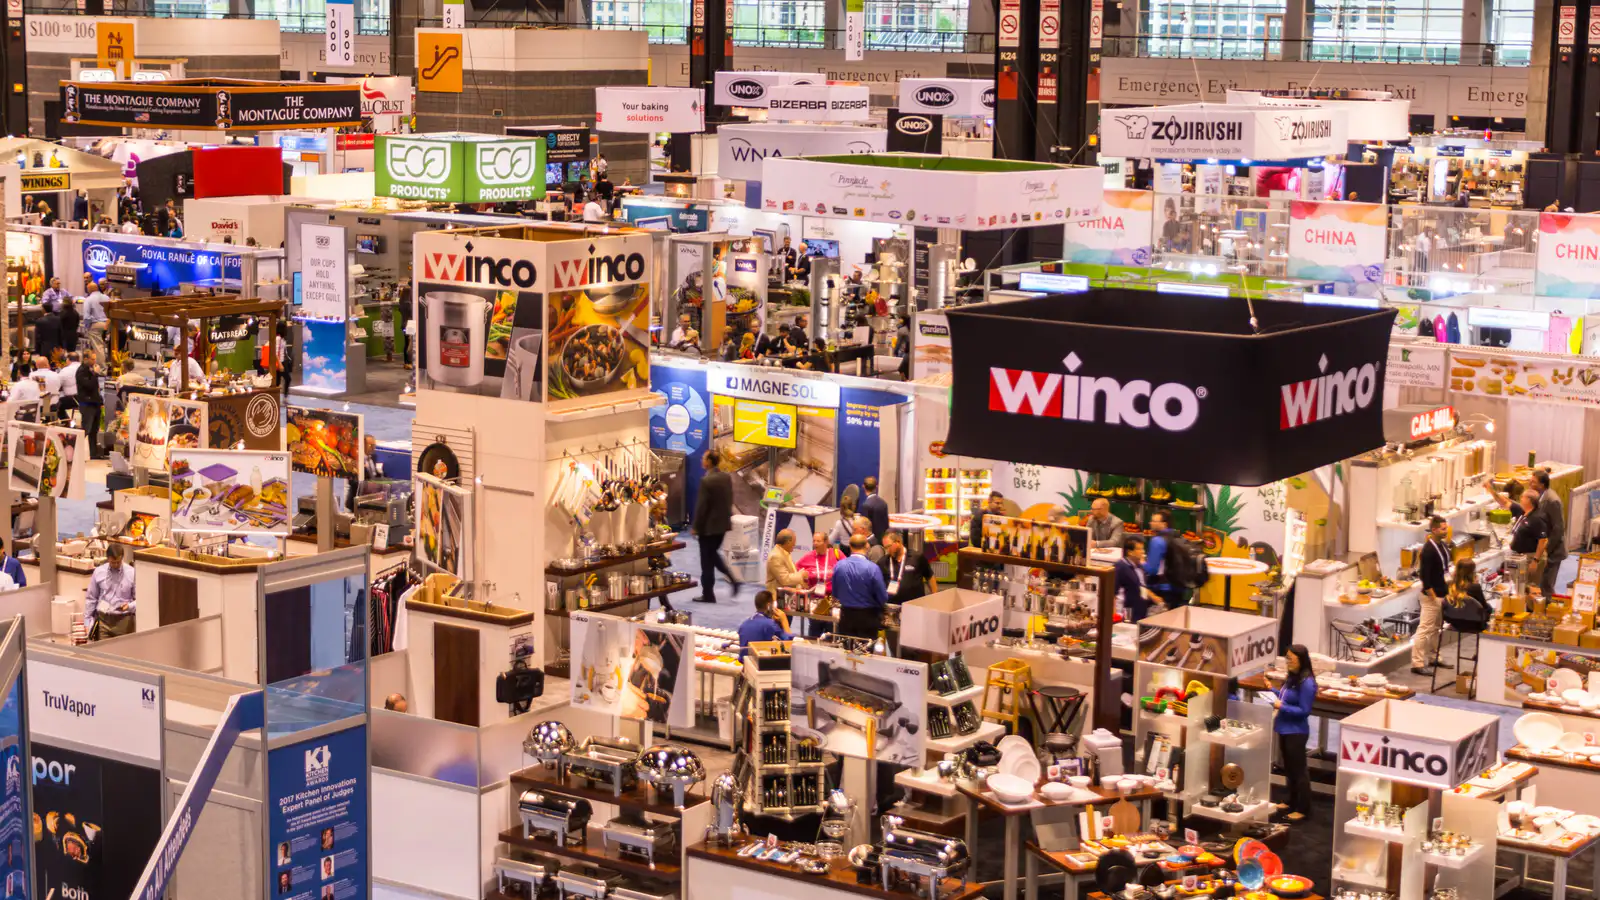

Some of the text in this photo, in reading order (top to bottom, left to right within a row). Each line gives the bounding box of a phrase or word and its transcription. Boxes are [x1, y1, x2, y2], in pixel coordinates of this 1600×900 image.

[30, 20, 96, 39] S100 to 106
[1000, 52, 1017, 60] K24
[1040, 53, 1057, 62] K24
[1039, 78, 1056, 87] FIRE
[1118, 77, 1239, 97] Emergency Exit
[731, 84, 761, 96] UNOX
[1038, 87, 1056, 96] HOSE
[84, 93, 201, 108] THE MONTAGUE COMPANY
[285, 95, 304, 107] THE
[917, 91, 951, 102] UNOX
[622, 103, 669, 112] Your baking
[770, 100, 827, 110] BIZERBA
[831, 100, 868, 110] BIZERBA
[238, 106, 354, 122] MONTAGUE COMPANY
[626, 114, 664, 122] solutions
[899, 121, 926, 130] UNOX
[1151, 115, 1242, 146] ZOJIRUSHI
[1291, 117, 1332, 144] ZOJIRUSHI
[21, 176, 63, 189] WININGS
[211, 221, 239, 230] David's
[1304, 228, 1357, 246] CHINA
[142, 249, 167, 262] ROYAL
[168, 252, 195, 264] RANGE
[196, 253, 208, 265] OF
[1555, 243, 1600, 261] CHIN
[310, 258, 336, 269] OUR CUPS
[316, 270, 330, 279] HOLD
[306, 291, 325, 301] EXCEPT
[134, 331, 163, 343] PASTRIES
[211, 329, 248, 340] FLATBREAD
[1403, 371, 1430, 381] shipping
[741, 376, 818, 400] MAGNESOL
[846, 416, 862, 426] 50%
[1014, 467, 1040, 478] of the
[1013, 477, 1041, 491] Best
[1257, 486, 1283, 498] Nat
[1264, 499, 1275, 510] of
[1263, 510, 1285, 522] Bes
[43, 690, 96, 717] TruVapor
[279, 778, 357, 806] 2017 Kitchen Innovations
[282, 787, 354, 814] Expert Panel of Judges
[62, 881, 89, 900] Both
